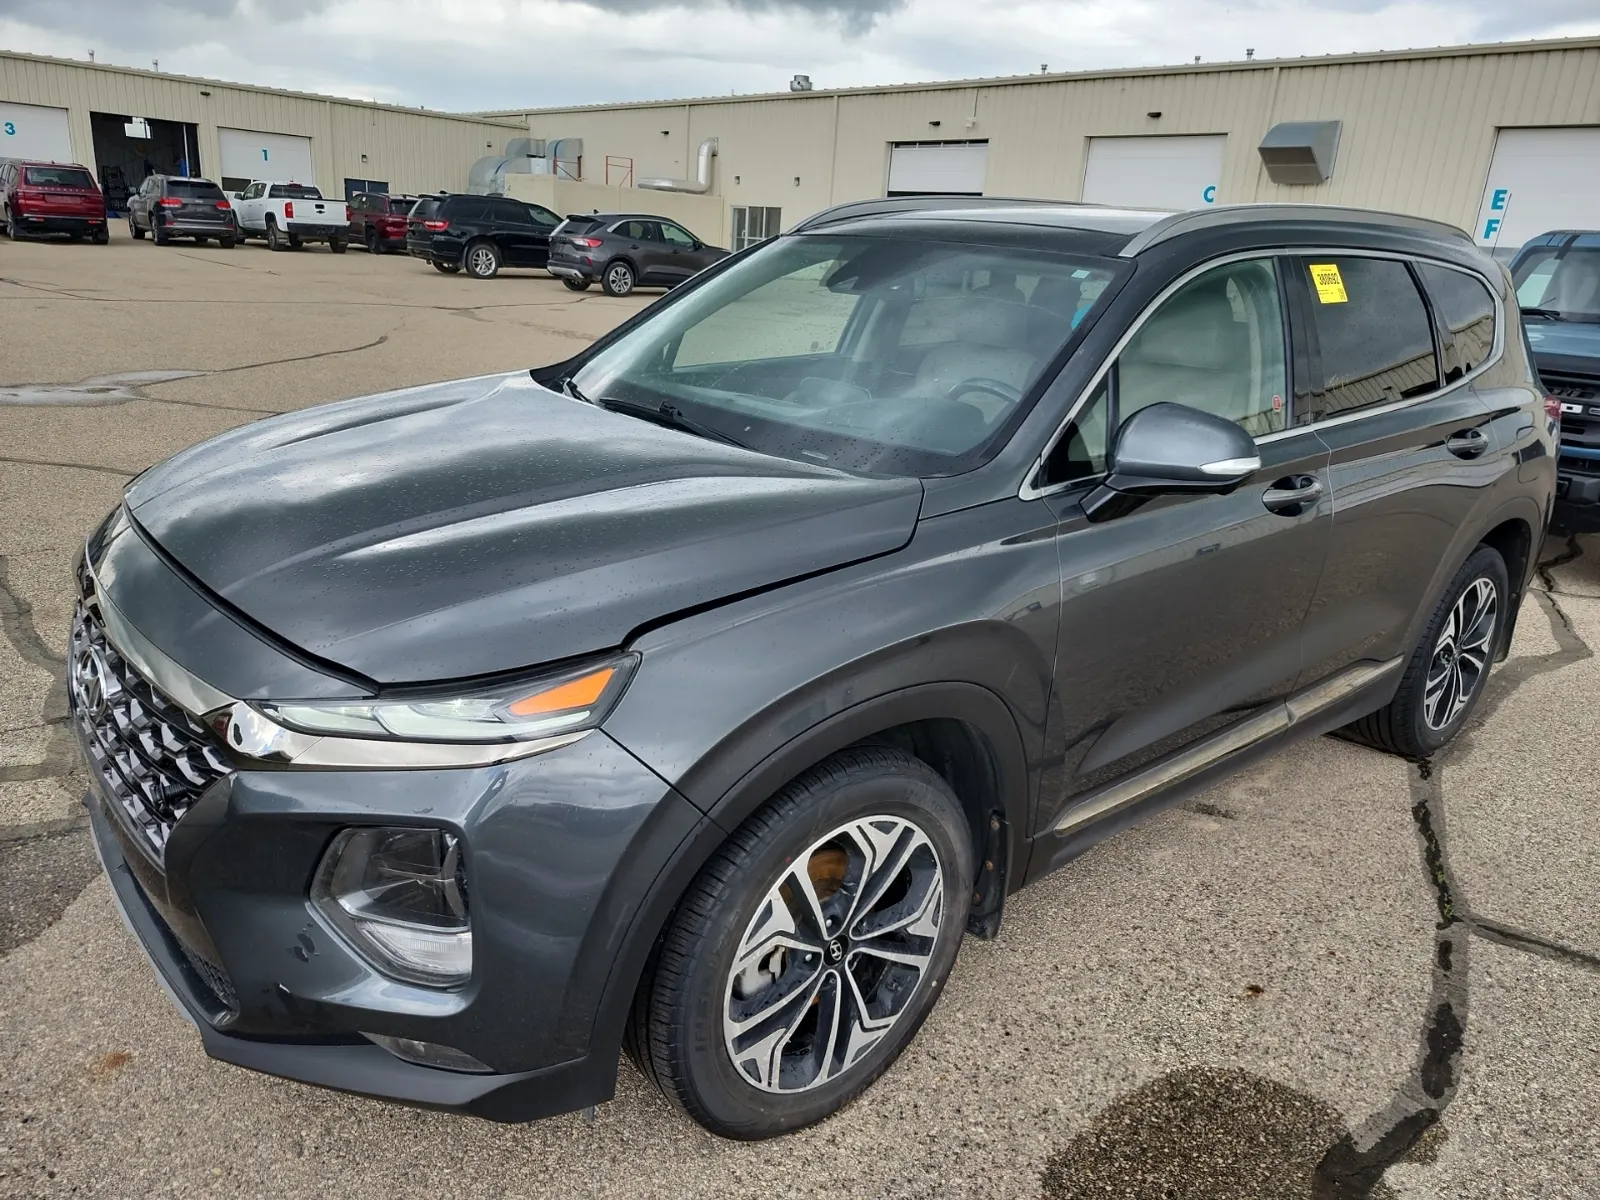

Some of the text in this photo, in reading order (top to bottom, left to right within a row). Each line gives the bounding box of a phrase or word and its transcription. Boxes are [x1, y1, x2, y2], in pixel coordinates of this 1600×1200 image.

[4, 122, 16, 136] 3
[261, 149, 269, 161] 1
[1203, 185, 1216, 203] C
[1491, 189, 1508, 210] E
[1483, 219, 1501, 239] F
